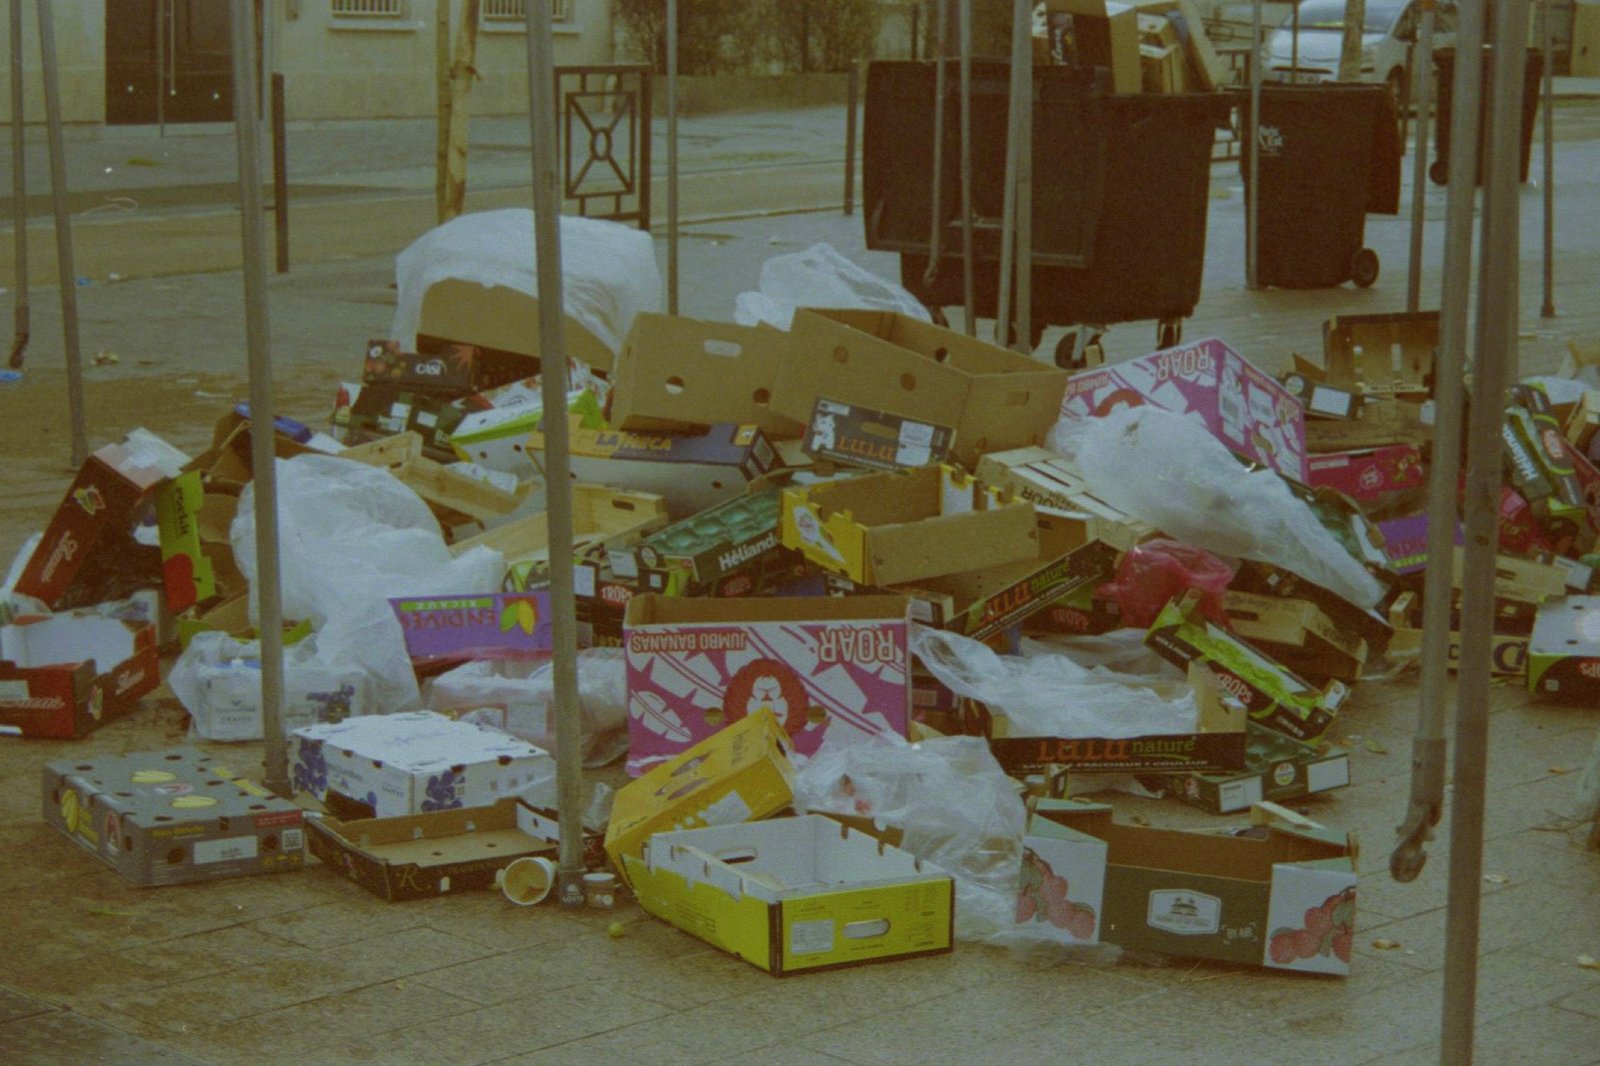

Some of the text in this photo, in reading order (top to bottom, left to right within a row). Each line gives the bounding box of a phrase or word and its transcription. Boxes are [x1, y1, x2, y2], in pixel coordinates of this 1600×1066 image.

[1157, 345, 1211, 382] ROAR
[718, 532, 776, 571] Héliand
[631, 631, 696, 654] BANANAS
[700, 631, 747, 651] JUMBO
[818, 629, 895, 663] ROAR
[1131, 738, 1194, 753] nature
